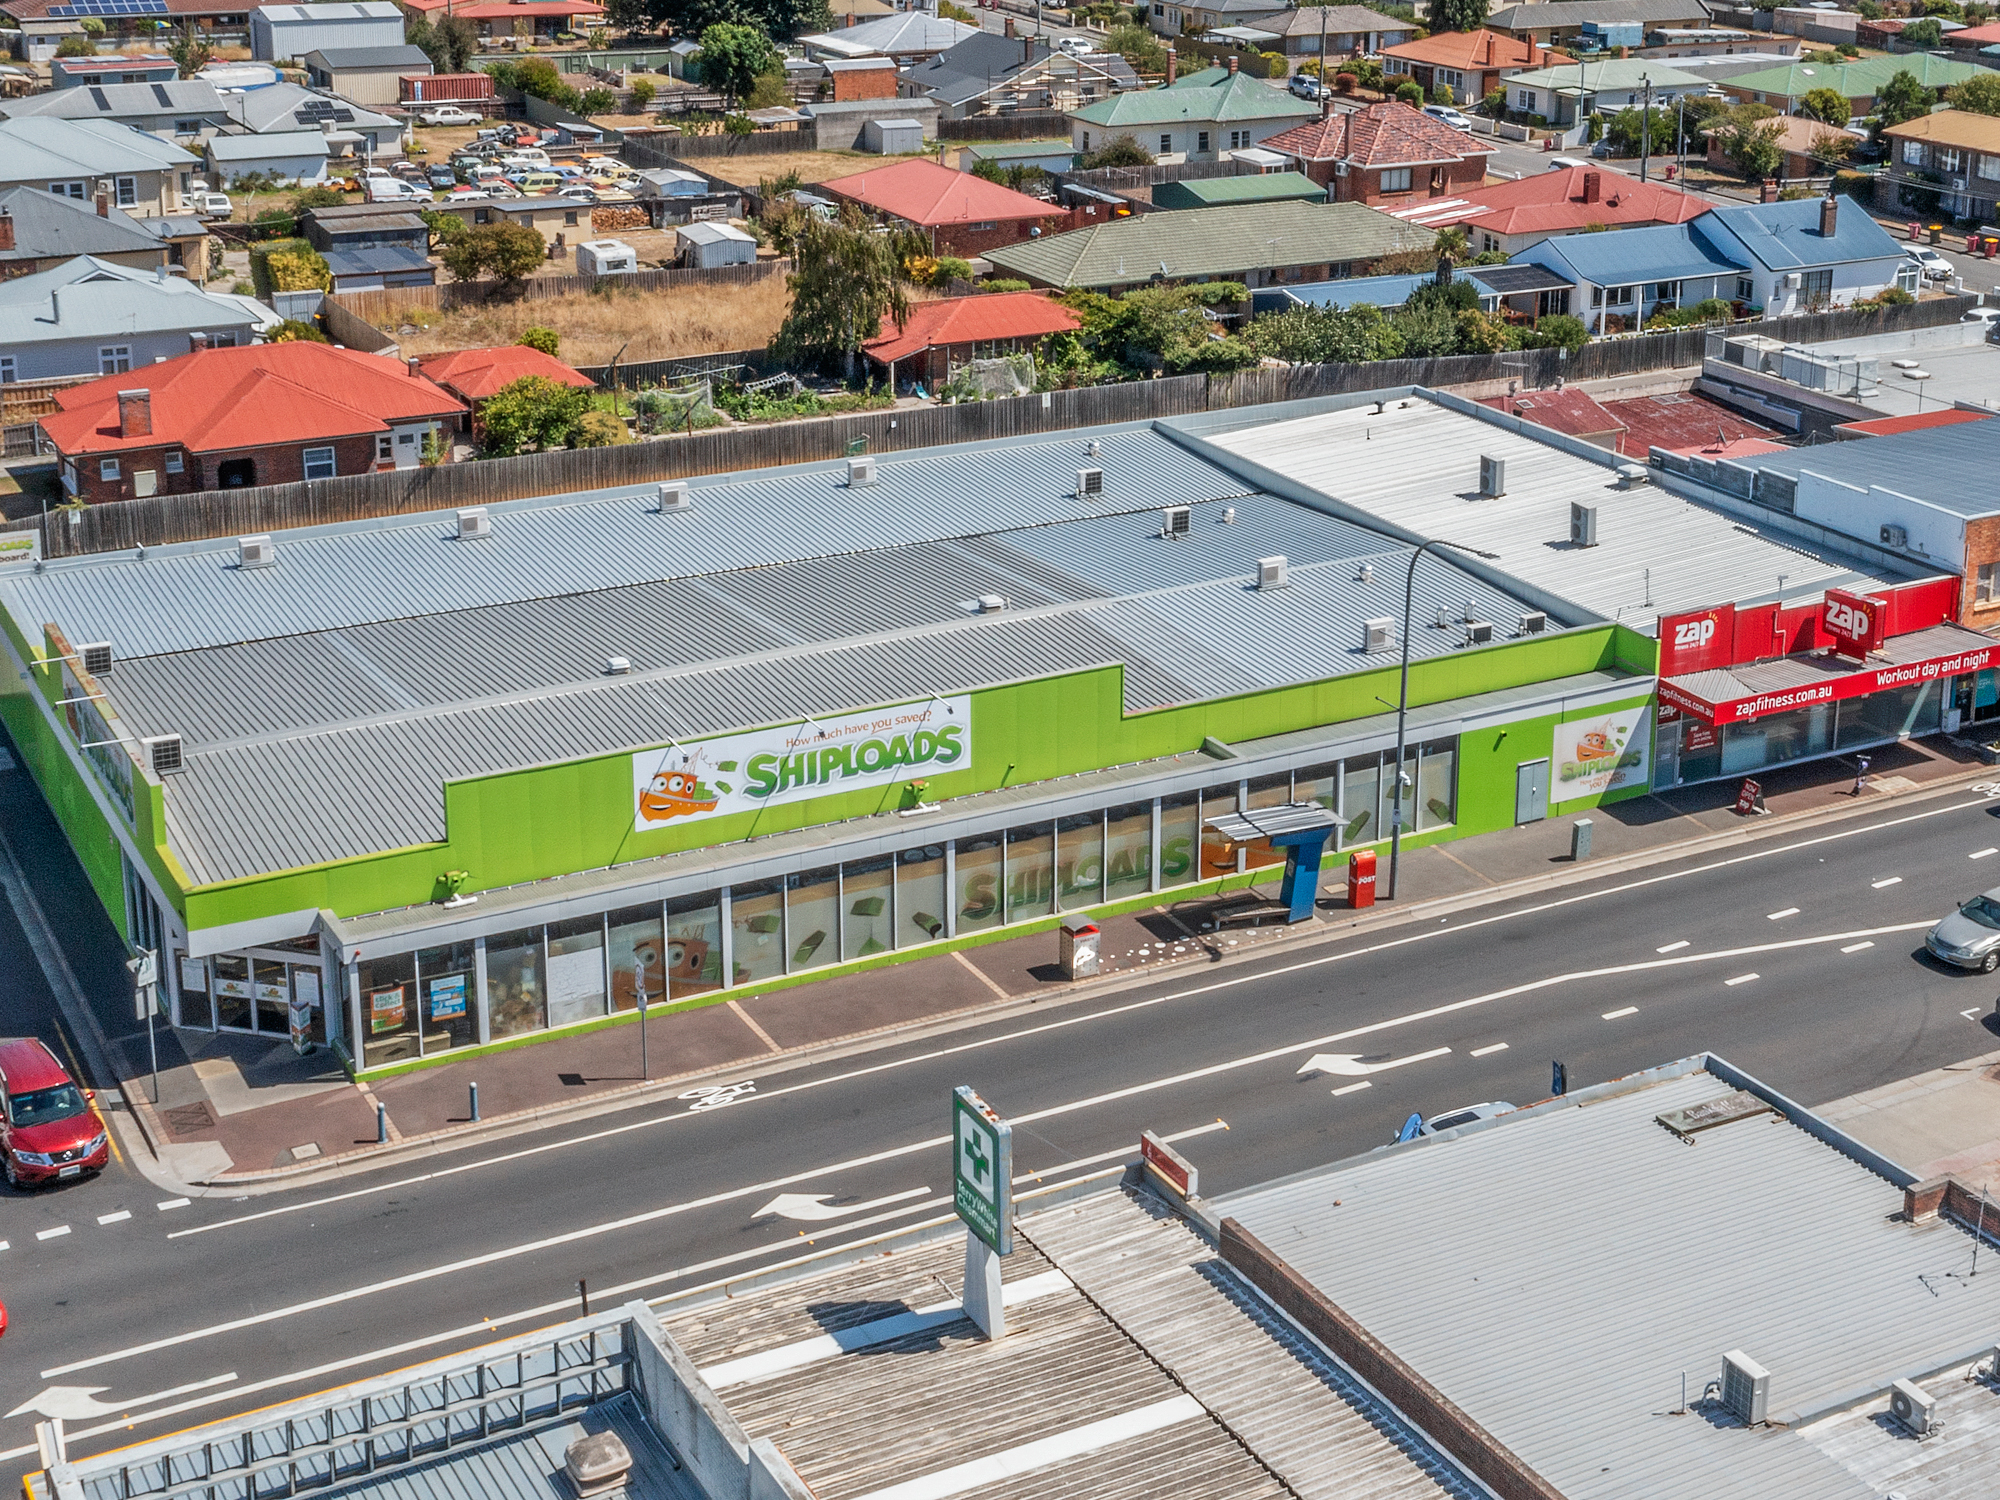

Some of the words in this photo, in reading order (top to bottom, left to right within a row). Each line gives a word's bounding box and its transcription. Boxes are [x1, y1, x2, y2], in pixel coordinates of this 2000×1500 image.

[1675, 619, 1715, 646] zap
[1826, 599, 1869, 640] zap
[1876, 666, 1921, 686] Workout
[1921, 662, 1941, 678] day
[1941, 655, 1961, 672] and
[1963, 650, 1991, 670] night
[1659, 687, 1714, 718] zapfitness.com.au
[1736, 685, 1833, 716] zapfitness.com.au
[785, 737, 811, 748] How
[813, 725, 843, 743] much
[844, 723, 869, 735] have
[871, 719, 892, 734] you
[895, 710, 932, 725] saved?
[743, 725, 963, 798] SHIPLOADS
[1560, 749, 1642, 782] SHIPLOADS
[1358, 875, 1376, 885] POST
[956, 1178, 998, 1229] TerryWhite
[957, 1194, 996, 1241] Chemmart
